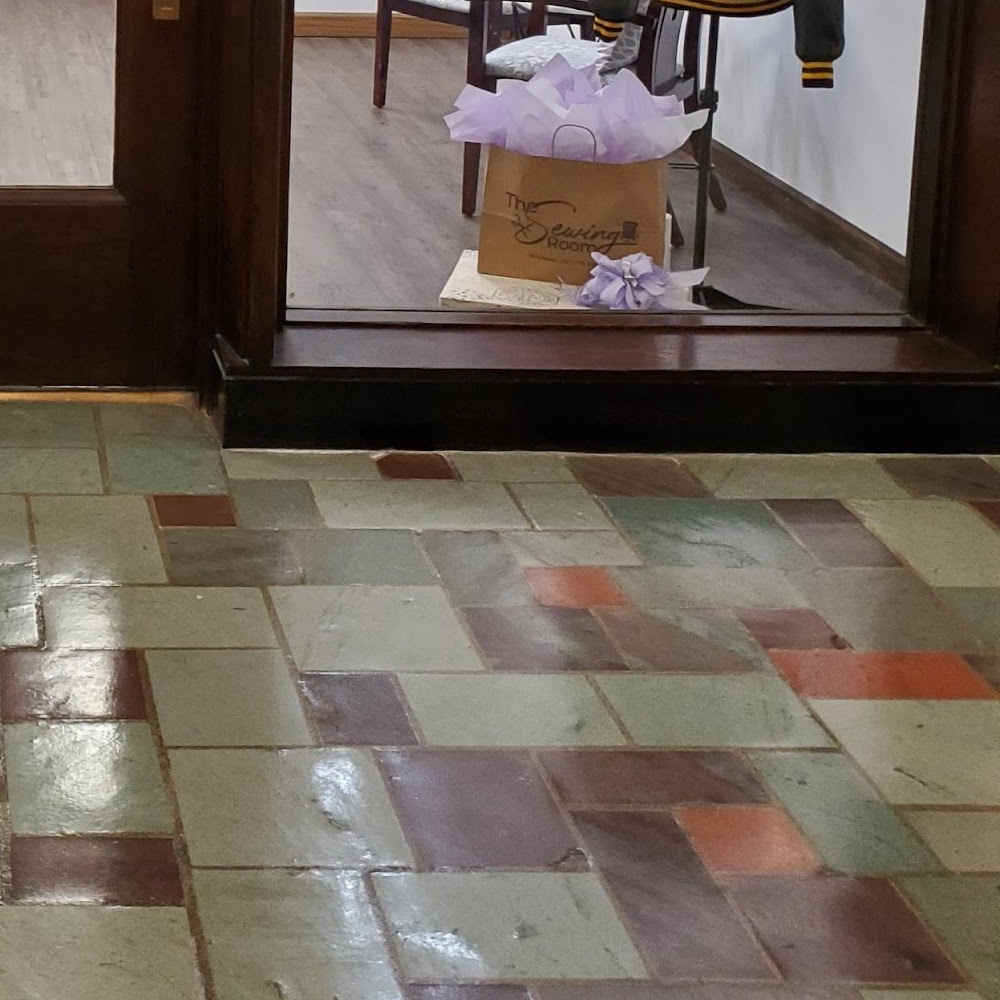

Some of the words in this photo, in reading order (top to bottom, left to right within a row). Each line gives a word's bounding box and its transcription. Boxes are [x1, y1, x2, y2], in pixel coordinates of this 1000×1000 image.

[506, 191, 538, 214] The
[514, 200, 638, 254] Sewing
[547, 236, 598, 253] Room
